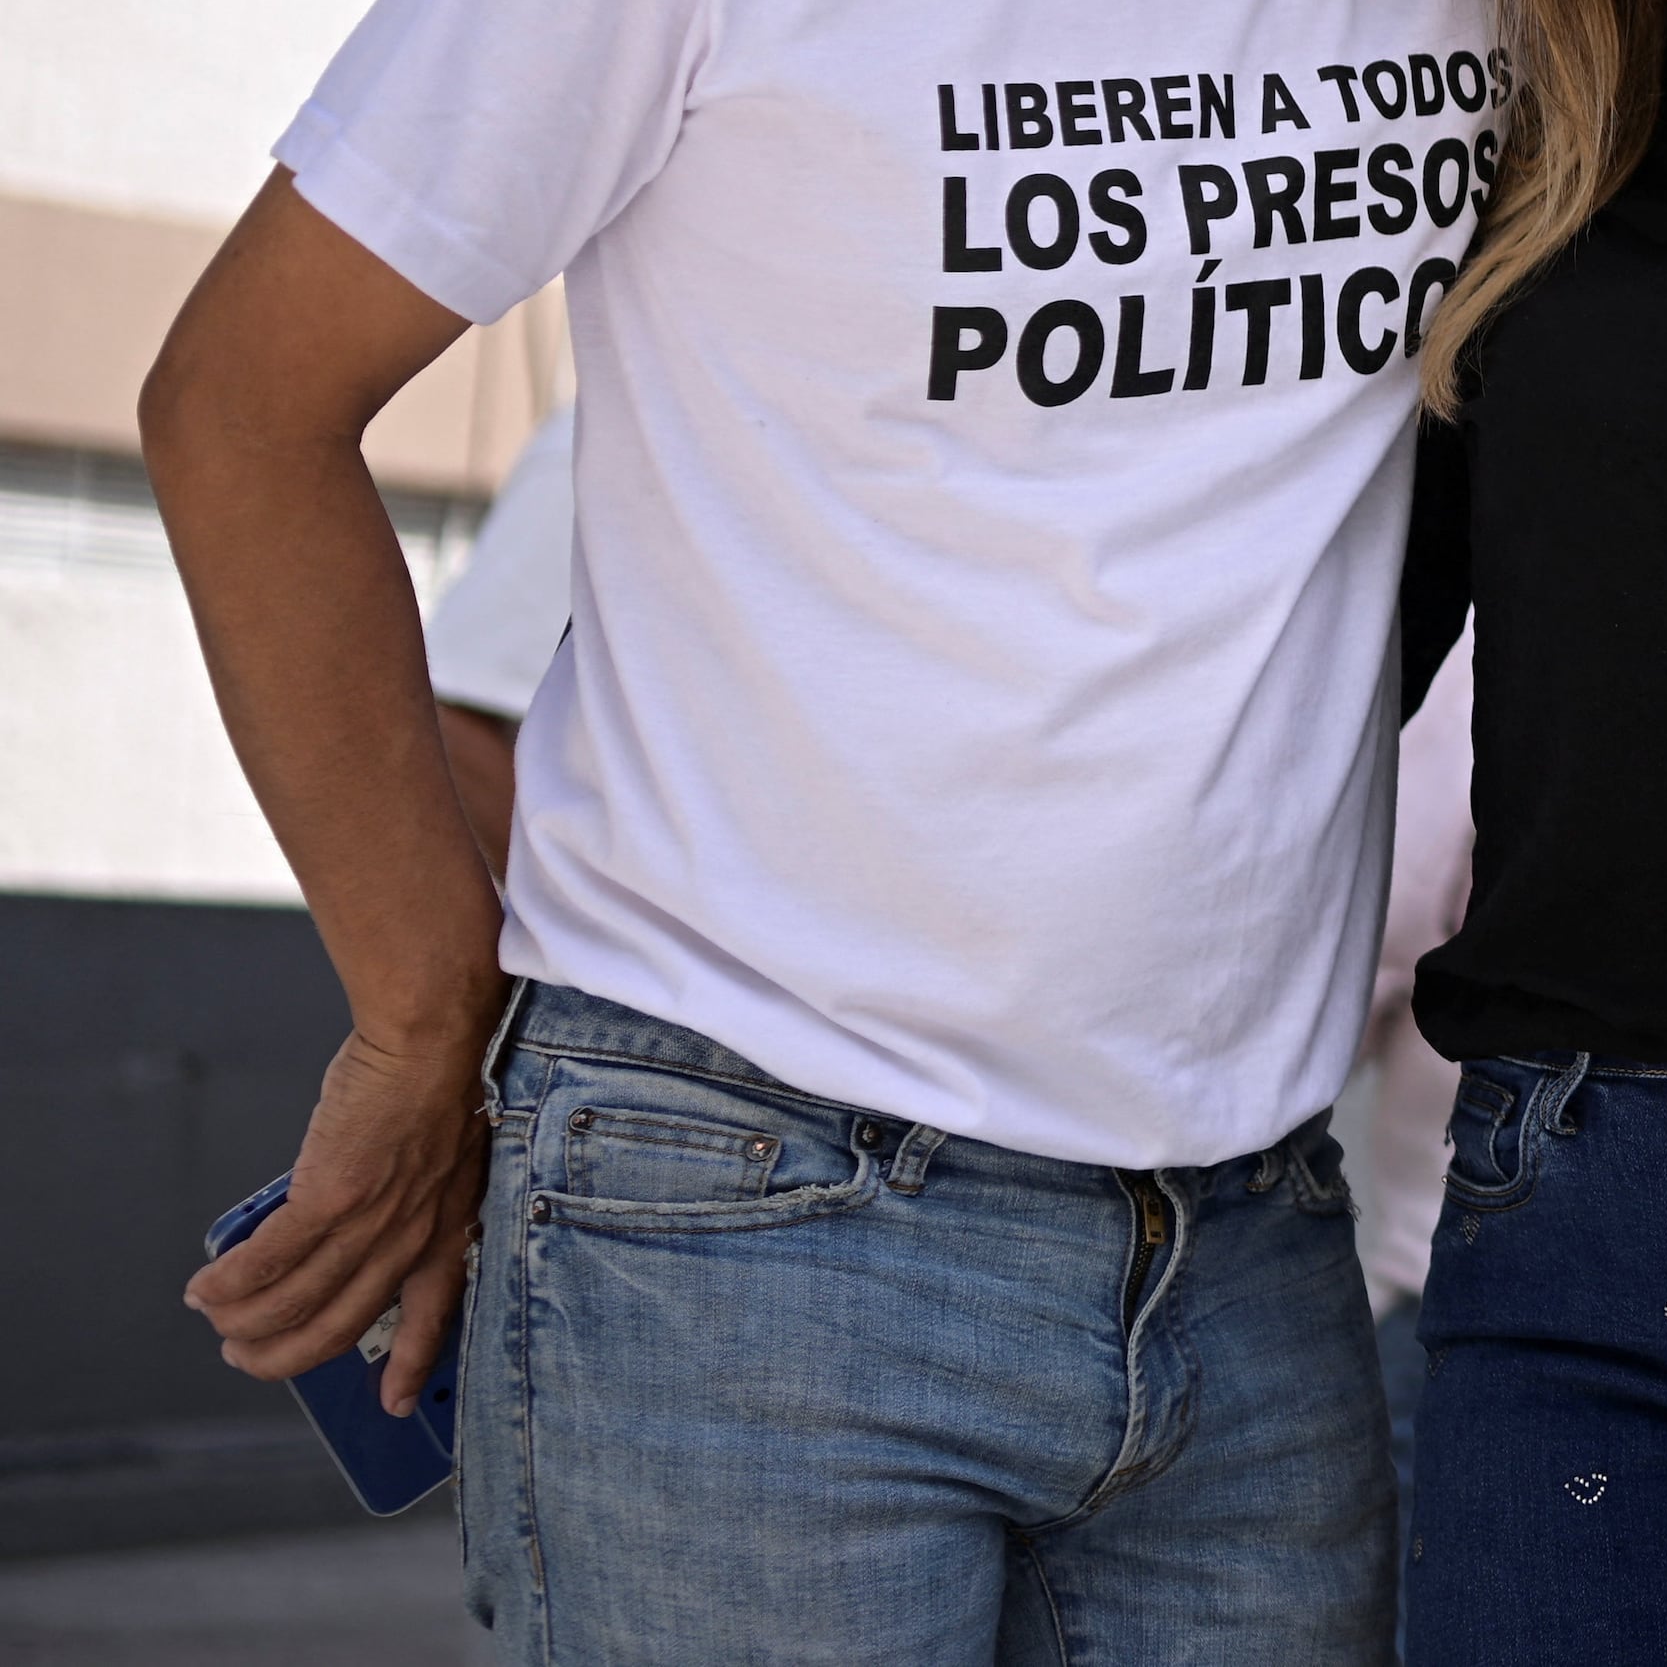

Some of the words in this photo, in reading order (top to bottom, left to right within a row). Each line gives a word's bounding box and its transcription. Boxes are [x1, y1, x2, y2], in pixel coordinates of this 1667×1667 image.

[938, 73, 1236, 152] LIBEREN
[1261, 73, 1311, 135] A
[1316, 47, 1513, 123] TODOS
[943, 168, 1148, 273] LOS
[1177, 129, 1499, 255] PRESOS
[927, 258, 1458, 408] POLÍTICO
